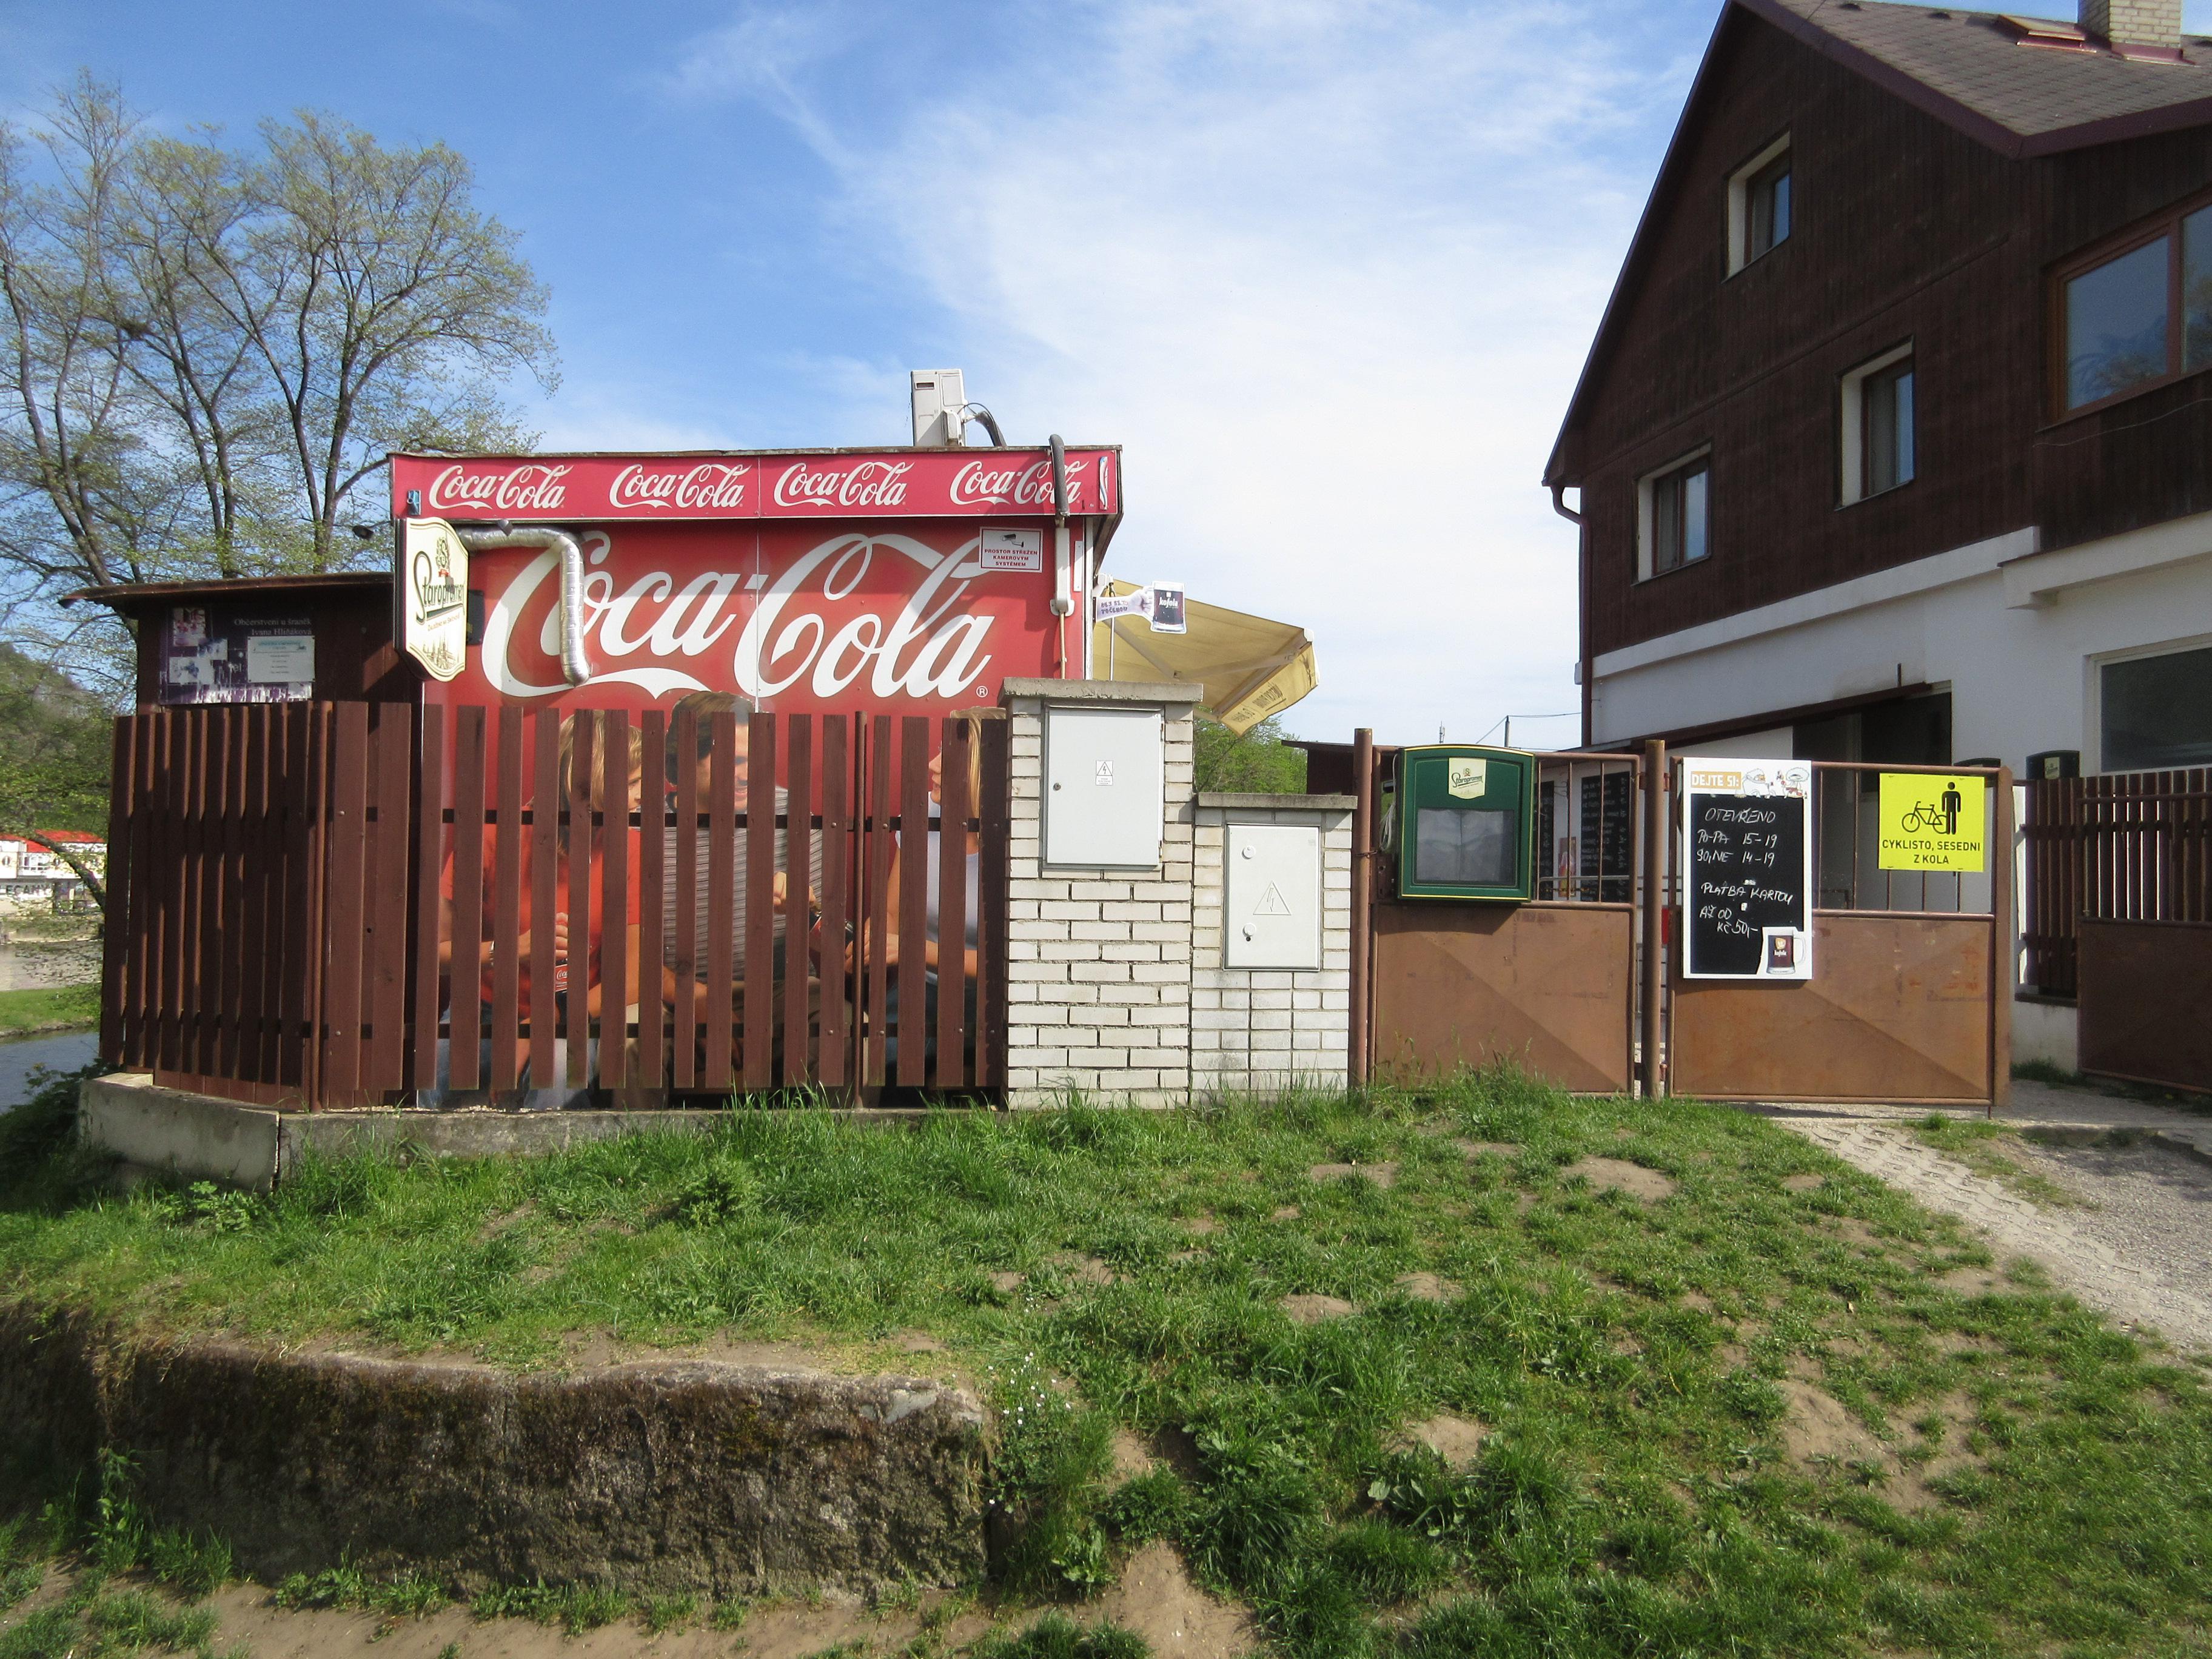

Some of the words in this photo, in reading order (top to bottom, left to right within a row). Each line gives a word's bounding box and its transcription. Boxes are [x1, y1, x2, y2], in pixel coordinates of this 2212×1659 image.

[429, 464, 574, 509] Coca-Cola
[609, 464, 751, 508] Coca-Cola
[774, 461, 914, 507] Coca-Cola
[414, 551, 465, 625] Staropramen
[1159, 597, 1178, 608] kofola
[1692, 774, 1724, 786] DEJTE
[1727, 775, 1739, 786] SI:
[1882, 839, 1934, 851] CYKLISTO,
[1937, 840, 1980, 851] SESEDNI
[1914, 854, 1919, 863] Z
[1923, 854, 1949, 864] KOLA
[1701, 882, 1746, 897] PLATBA
[1750, 888, 1793, 905] KARTOU
[1718, 907, 1732, 919] OD
